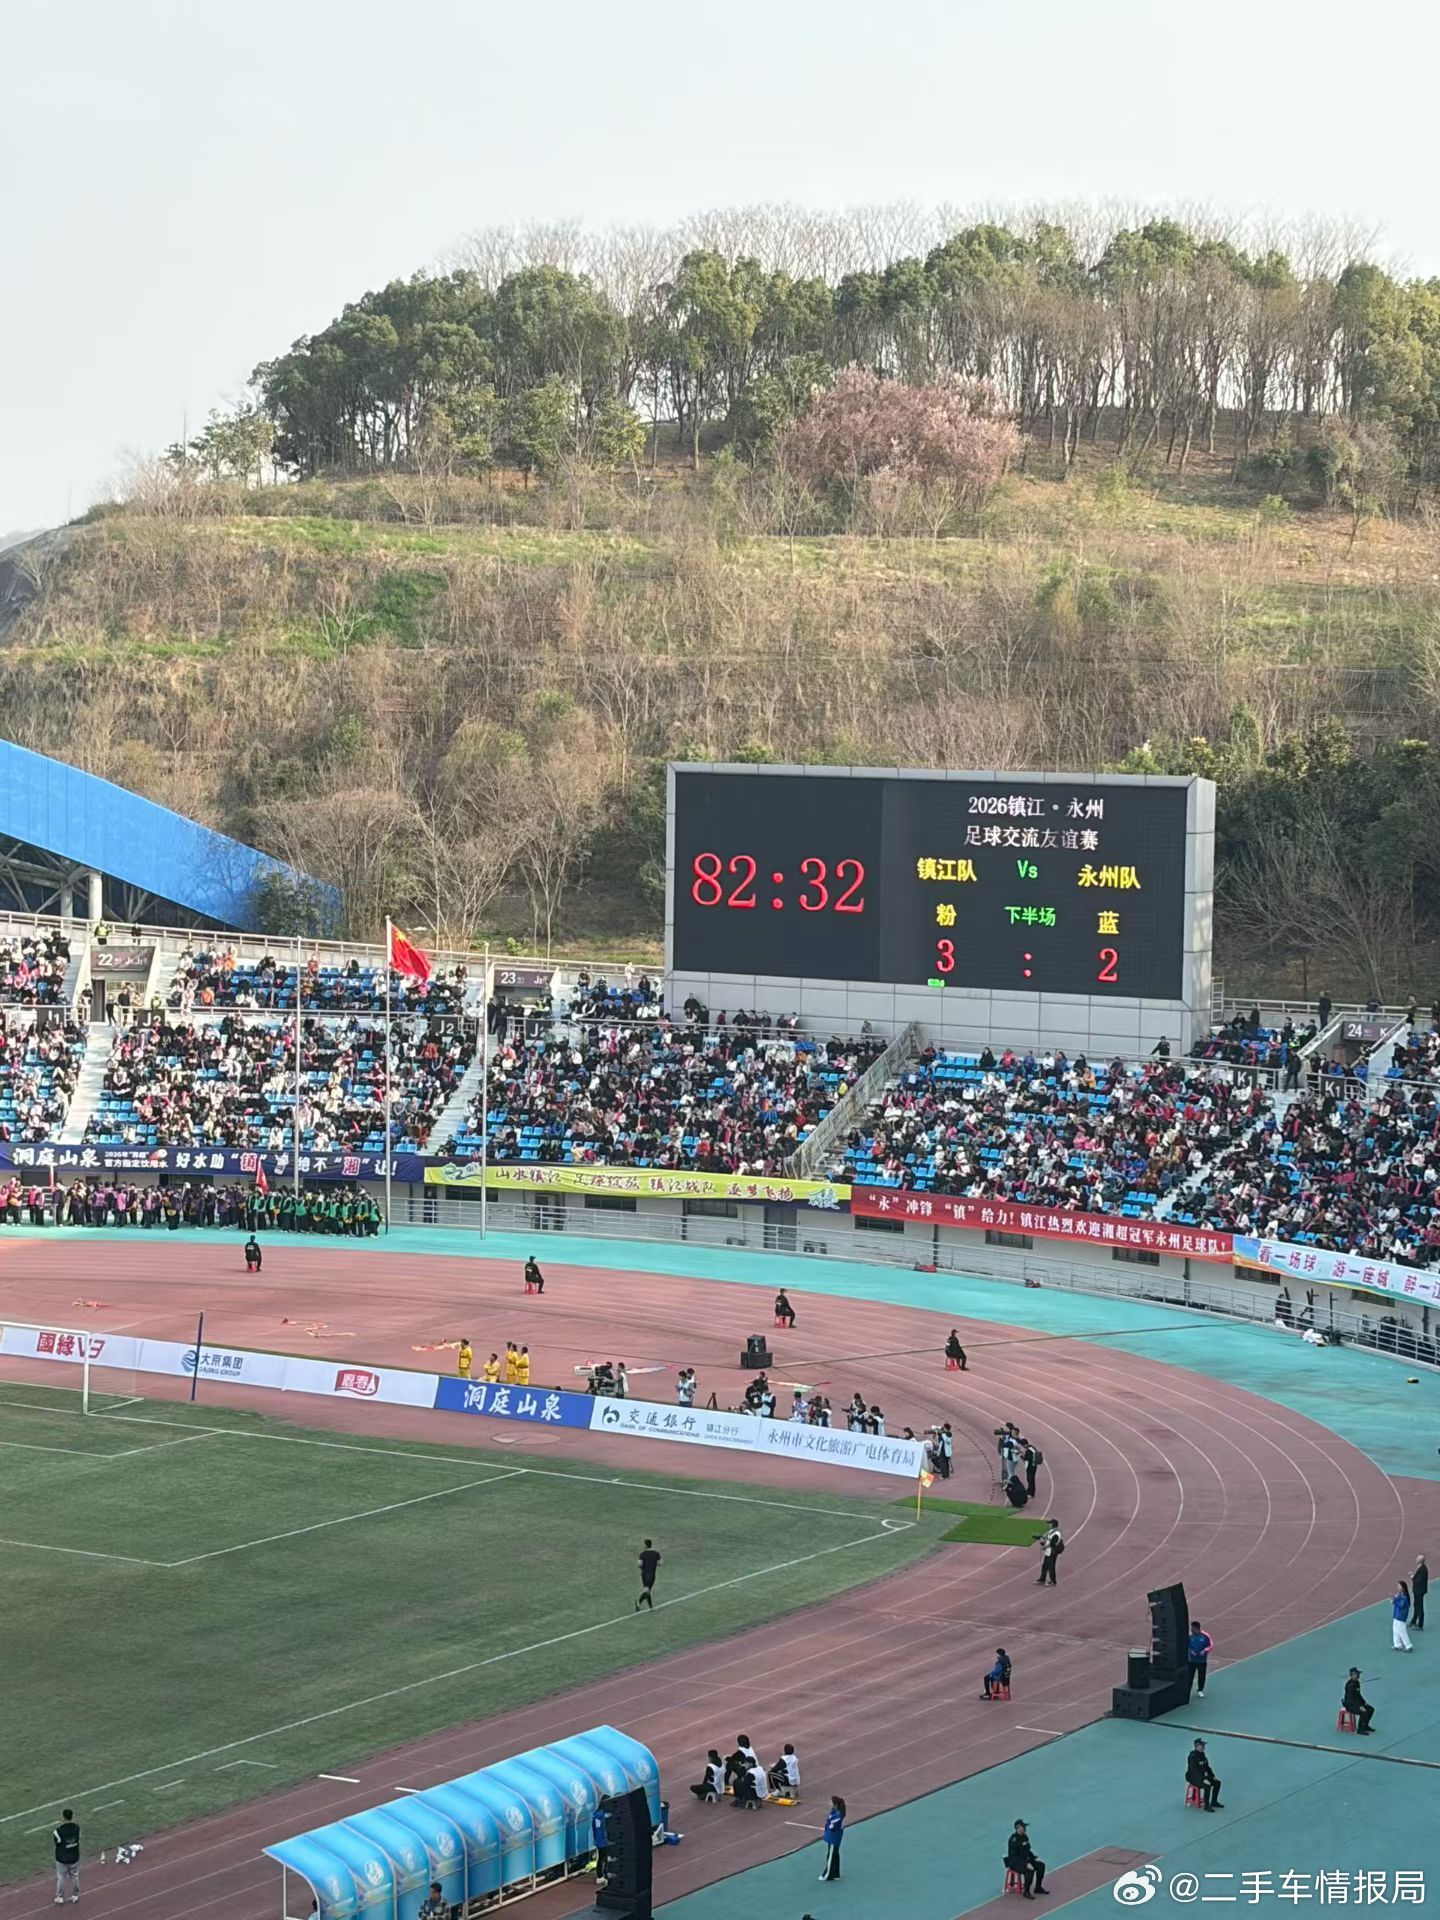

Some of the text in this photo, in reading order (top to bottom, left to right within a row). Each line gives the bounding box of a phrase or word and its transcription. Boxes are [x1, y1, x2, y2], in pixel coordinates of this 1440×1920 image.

[964, 825, 1099, 851] 足球交流友谊赛
[691, 852, 866, 913] 82:32
[916, 857, 1142, 890] 镇江队 Vs 永州队
[936, 903, 1120, 935] 粉 下半场 蓝
[98, 953, 113, 966] 22
[936, 938, 955, 973] 3
[1098, 948, 1119, 982] 2
[501, 971, 516, 984] 23
[439, 1019, 455, 1035] J2
[1348, 1023, 1362, 1037] 24
[1325, 1080, 1340, 1098] K1
[12, 1147, 101, 1168] 洞庭山泉
[463, 1384, 562, 1421] 洞庭山泉
[768, 1428, 915, 1467] 永州市文化旅游广电体育局
